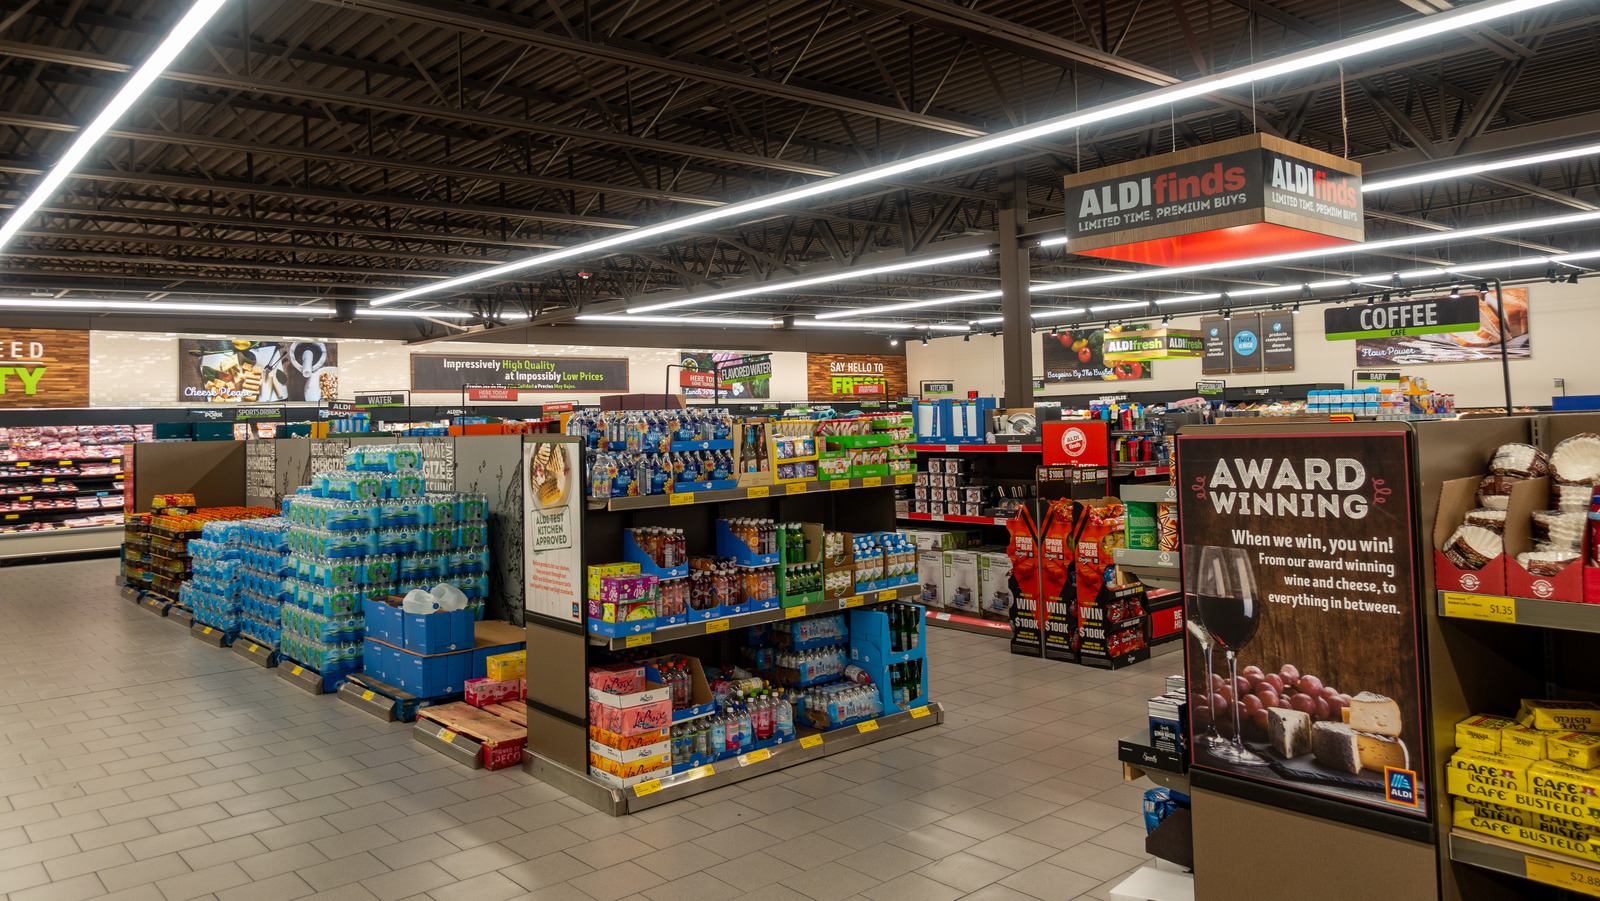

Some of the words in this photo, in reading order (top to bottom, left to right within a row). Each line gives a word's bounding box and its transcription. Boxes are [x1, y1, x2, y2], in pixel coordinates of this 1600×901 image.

[1272, 158, 1358, 208] ALDIfinds
[1078, 163, 1246, 219] ALDIfinds
[1078, 216, 1121, 232] LIMITED
[1123, 210, 1154, 222] TIME,
[1156, 200, 1211, 218] PREMIUM
[1214, 193, 1247, 207] BUYS
[1272, 192, 1298, 207] LIMITED
[1299, 198, 1315, 213] TIME,
[1316, 204, 1342, 219] PREMIUM
[1343, 209, 1358, 222] BUYS
[1360, 303, 1438, 331] COFFEE
[1390, 327, 1407, 337] CAFÉ
[1109, 338, 1163, 352] ALDIfresh
[1169, 336, 1203, 350] ALDIfresh
[1361, 347, 1386, 358] Flour
[1387, 346, 1416, 356] Power
[444, 358, 501, 371] Impressively
[502, 360, 523, 372] High
[524, 360, 555, 372] Quality
[722, 365, 750, 380] FLAVORED
[750, 362, 771, 375] WATER
[830, 362, 846, 372] SAY
[847, 362, 872, 372] HELLO
[873, 363, 884, 373] TO
[504, 372, 515, 380] at
[516, 372, 561, 383] Impossibly
[563, 372, 578, 381] Low
[580, 372, 604, 381] Prices
[1047, 370, 1072, 380] Bargains
[1072, 370, 1082, 379] By
[1082, 368, 1093, 377] The
[1370, 373, 1387, 381] BABY
[184, 386, 217, 397] Cheese
[219, 386, 253, 397] Please
[367, 396, 392, 404] WATER
[1066, 435, 1080, 443] ALDI
[311, 457, 344, 472] ENERGIZE
[445, 443, 453, 480] REVIVE
[1209, 458, 1366, 490] AWARD
[1210, 491, 1368, 519] WINNING
[536, 516, 549, 525] ALDI
[550, 513, 564, 523] TEST
[538, 524, 563, 535] KITCHEN
[536, 535, 567, 546] APPROVED
[1232, 529, 1271, 547] When
[1273, 535, 1293, 548] we
[1295, 534, 1326, 552] win,
[1329, 538, 1357, 555] you
[1359, 536, 1394, 553] win!
[1258, 552, 1285, 566] From
[1287, 556, 1306, 568] our
[1308, 556, 1343, 570] award
[1345, 560, 1395, 577] winning
[1284, 575, 1311, 587] wine
[1312, 576, 1333, 589] and
[1336, 578, 1381, 594] cheese,
[1382, 580, 1396, 593] to
[1016, 598, 1036, 611] WIN
[1046, 601, 1067, 615] WIN
[1268, 592, 1334, 611] everything
[1331, 596, 1341, 608] in
[1344, 597, 1400, 614] between.
[1490, 604, 1513, 615] $1.35
[1080, 607, 1103, 620] WIN
[1015, 617, 1039, 629] $100K
[1045, 620, 1068, 633] $100K
[1079, 627, 1105, 639] $100K
[1391, 788, 1412, 799] ALDI
[1515, 794, 1583, 817] BUSTELO
[1474, 806, 1523, 826] USTELO
[1519, 829, 1586, 853] BUSTELO
[1570, 871, 1600, 887] $2.88
